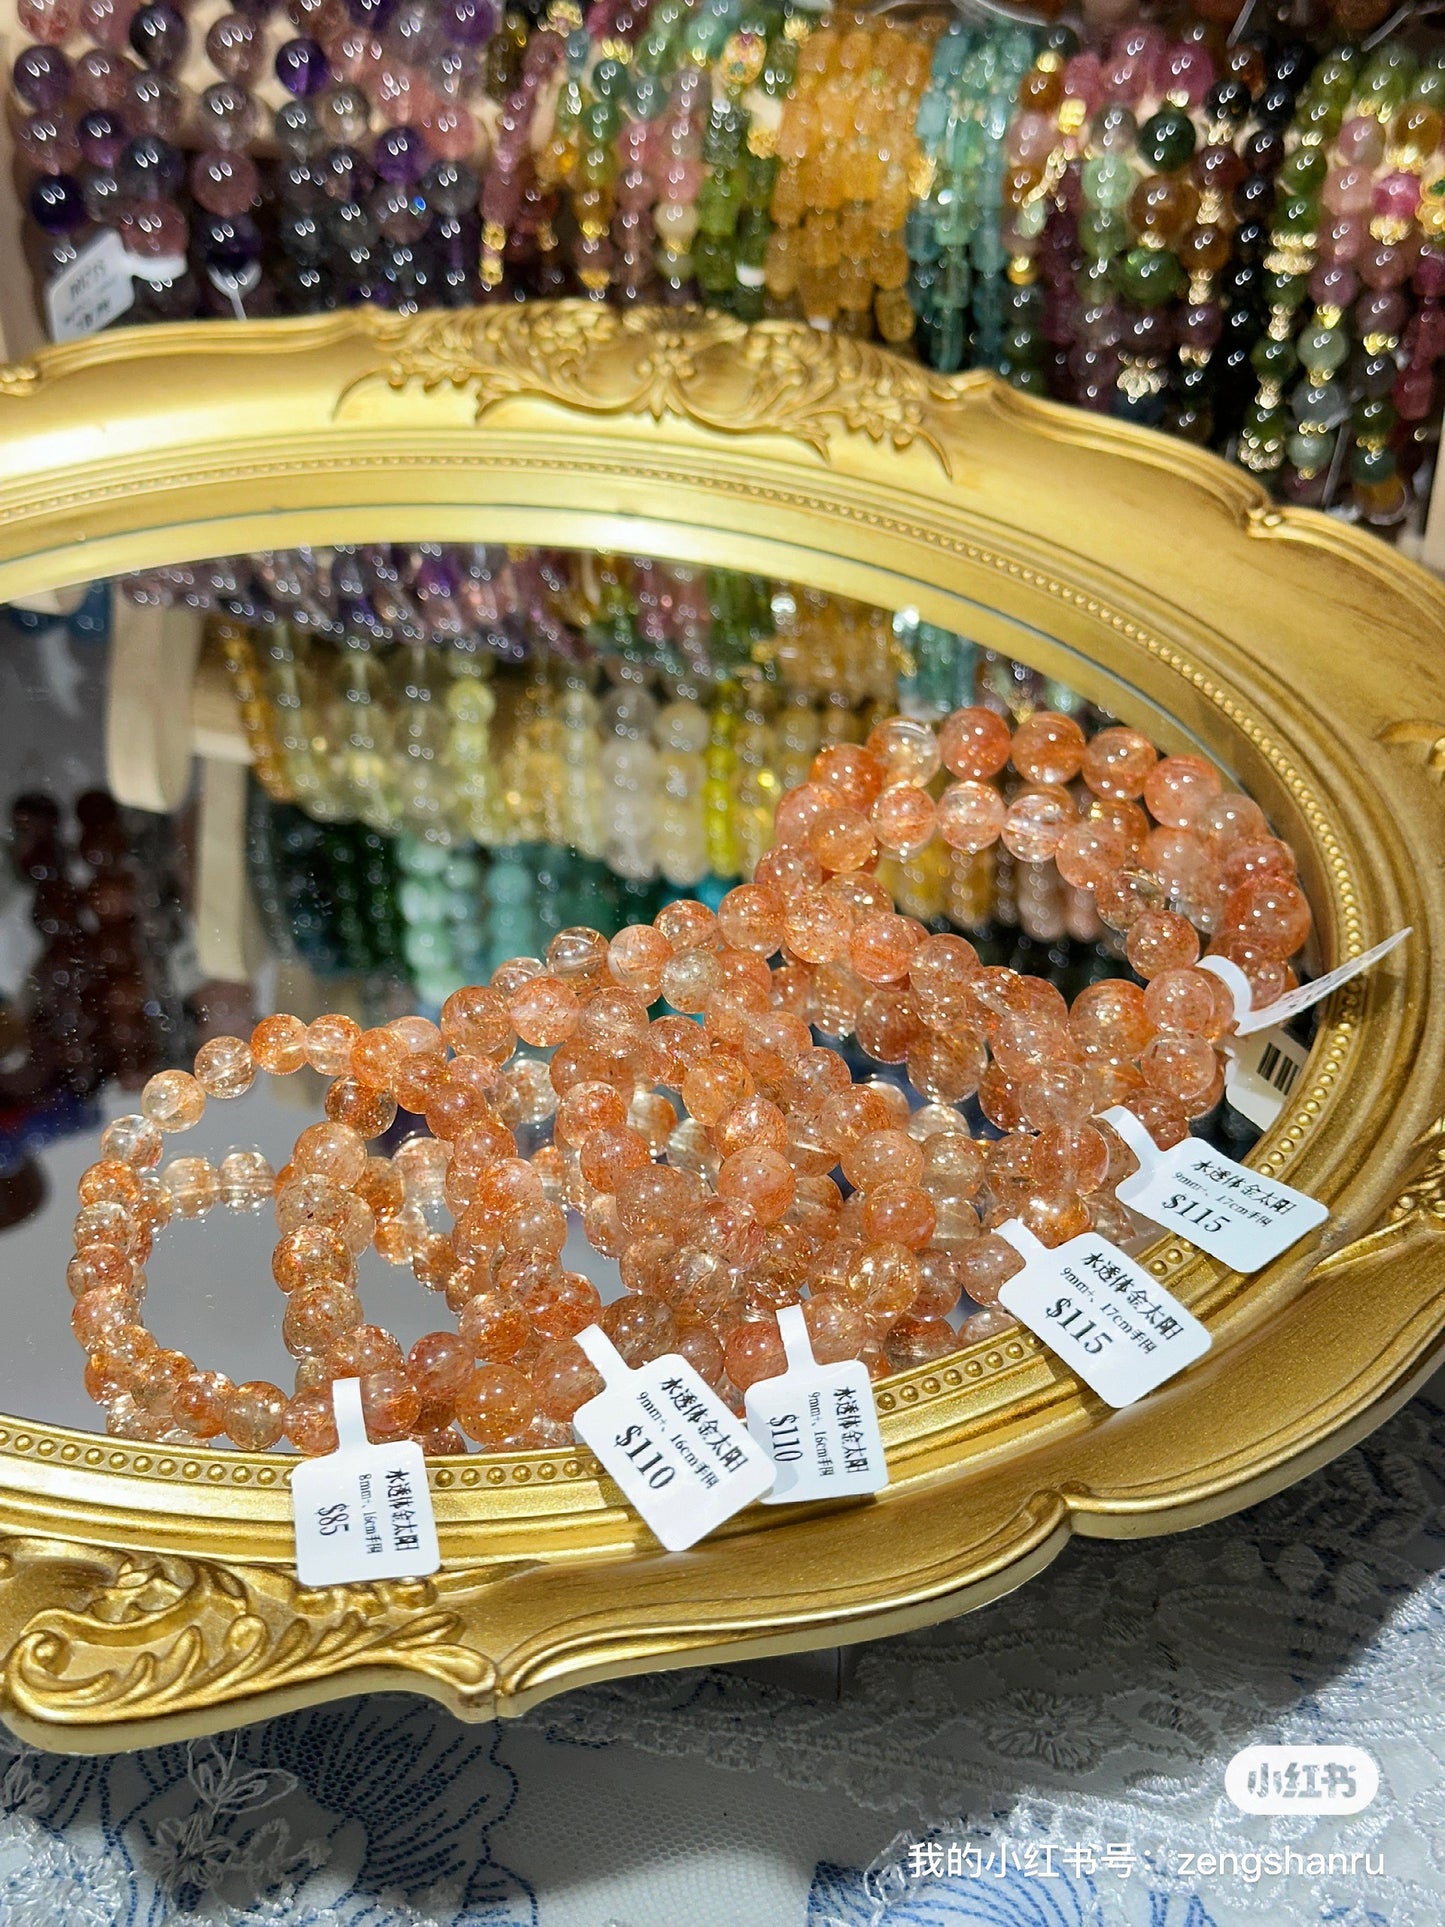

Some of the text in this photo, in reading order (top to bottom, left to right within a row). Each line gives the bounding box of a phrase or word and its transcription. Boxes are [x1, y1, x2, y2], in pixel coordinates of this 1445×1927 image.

[1161, 1192, 1231, 1234] $115
[1080, 1252, 1184, 1341] 水透体金太阳
[1045, 1297, 1115, 1355] $115
[659, 1376, 749, 1473] 水透体金太阳
[768, 1414, 803, 1462] $110
[614, 1425, 676, 1490] $110
[314, 1503, 350, 1536] $85
